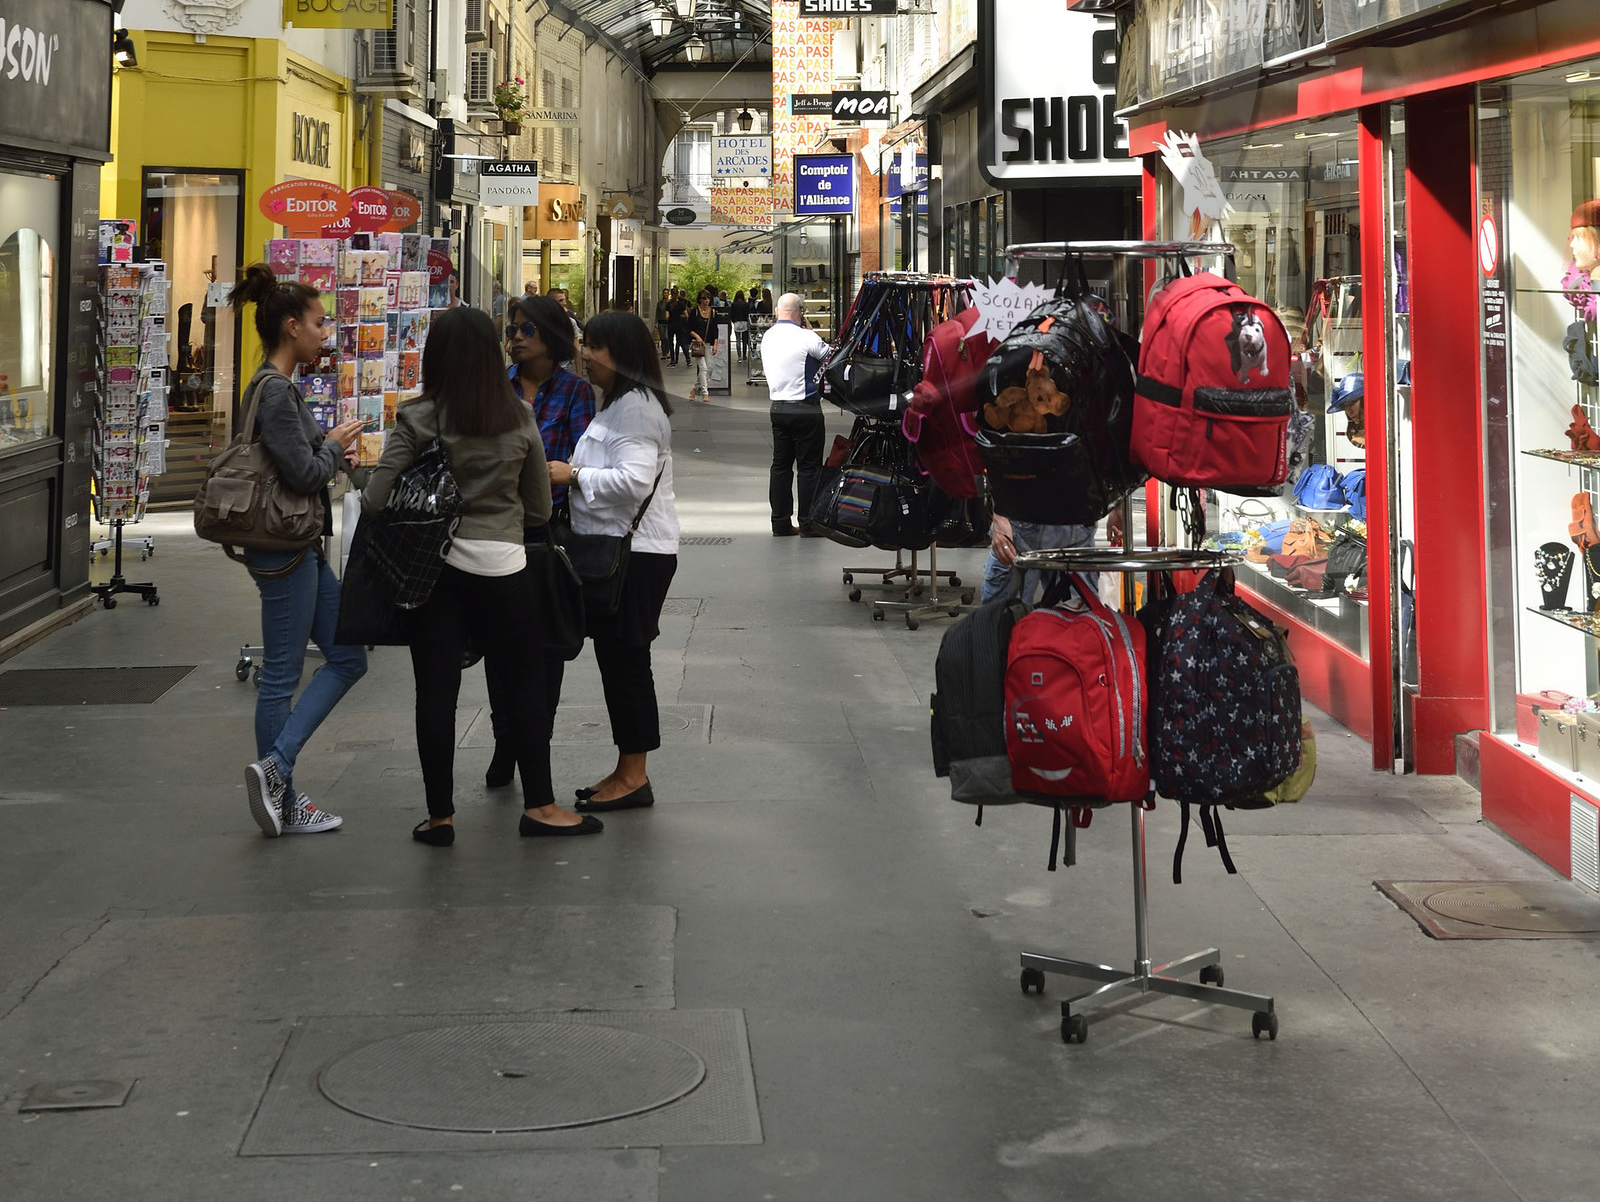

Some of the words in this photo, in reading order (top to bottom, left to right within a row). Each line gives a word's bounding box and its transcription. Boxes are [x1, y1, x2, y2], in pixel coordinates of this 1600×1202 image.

[834, 96, 889, 115] MOA
[293, 111, 332, 169] BOCAGE
[717, 139, 767, 148] HOTEL
[716, 155, 768, 166] ARCADES
[487, 164, 531, 173] AGATHA
[799, 164, 849, 178] Comptoir
[270, 181, 308, 195] FABRICATION
[309, 181, 342, 194] FRANÇAISE
[817, 179, 832, 191] de
[286, 197, 338, 213] EDITOR
[800, 194, 851, 206] l'Alliance
[358, 201, 388, 216] EDITOR
